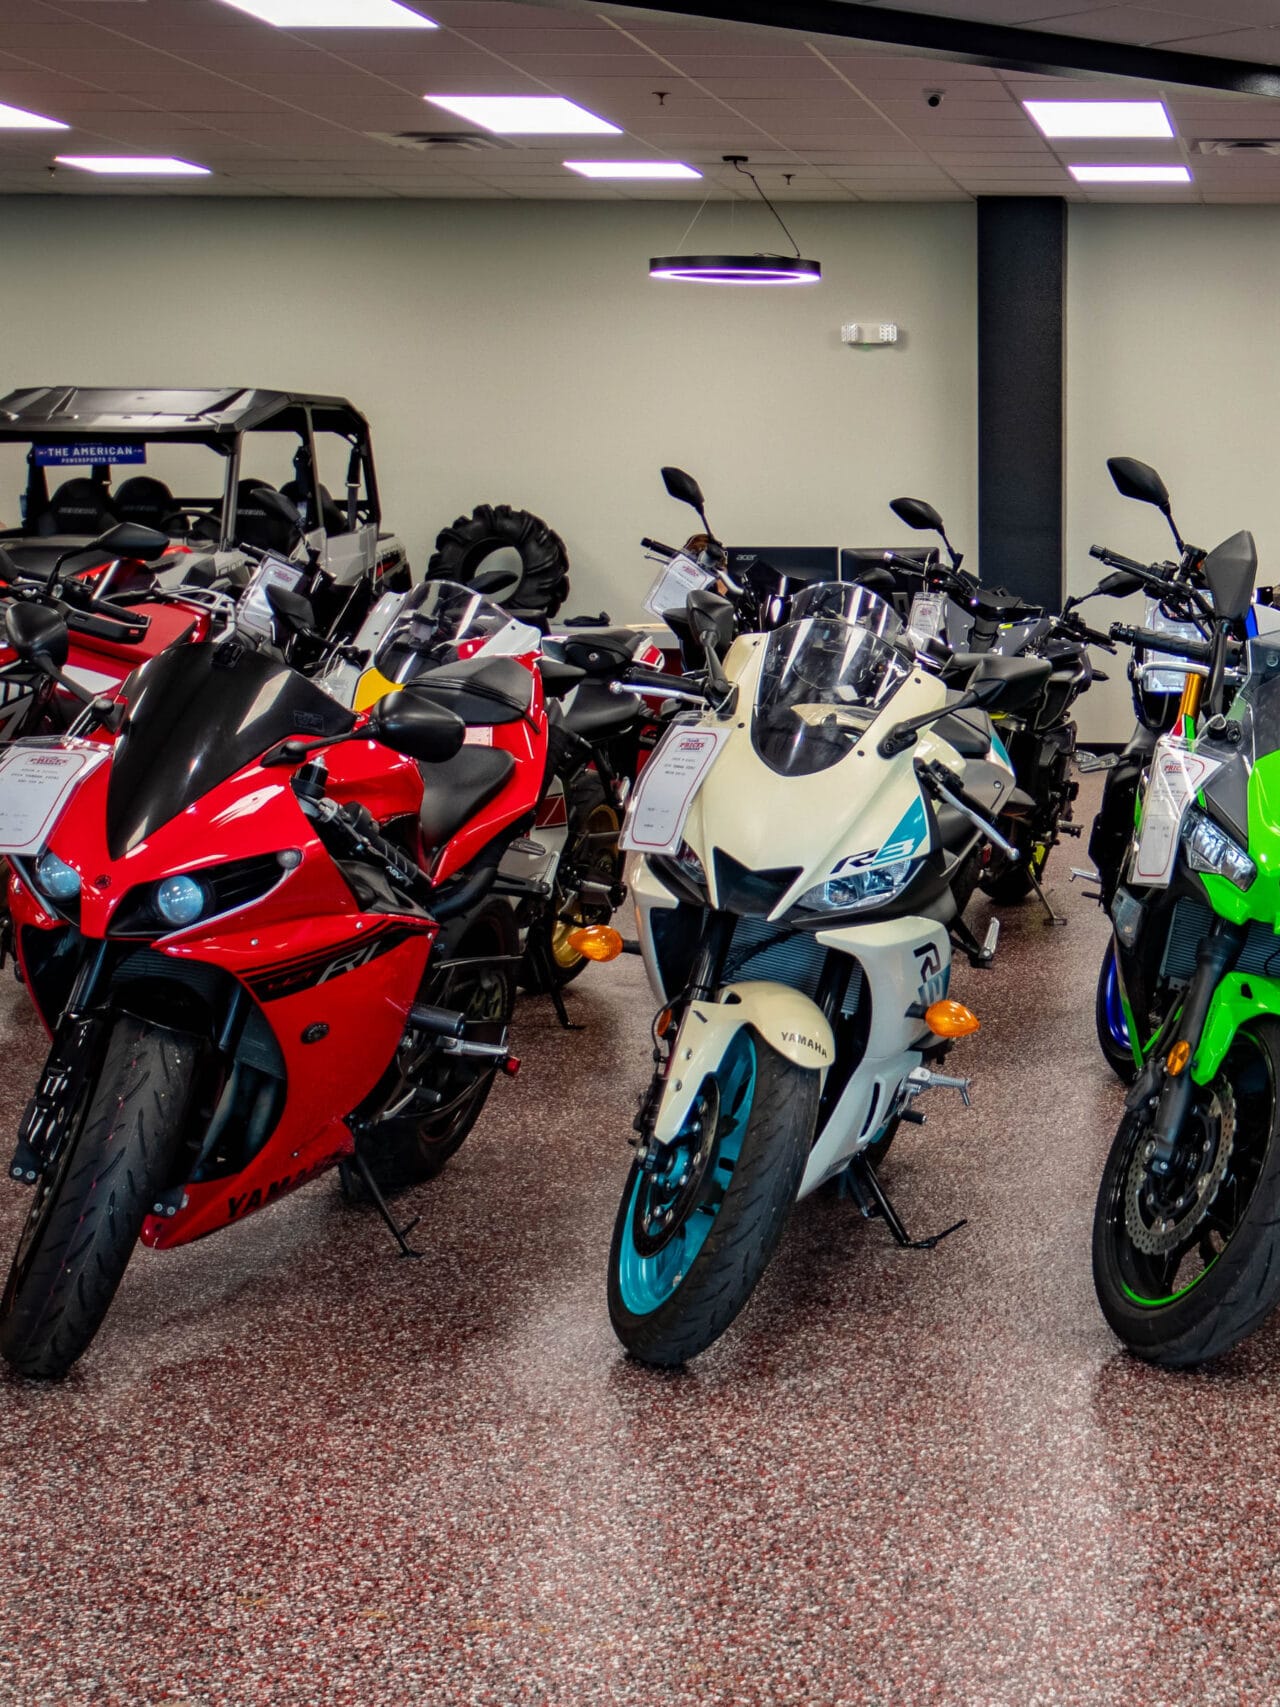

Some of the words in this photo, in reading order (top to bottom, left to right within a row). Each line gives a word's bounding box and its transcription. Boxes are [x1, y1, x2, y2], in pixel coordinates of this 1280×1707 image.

[47, 447, 69, 456] THE
[73, 446, 133, 456] AMERICAN
[829, 838, 915, 875] R3
[780, 1031, 828, 1059] YAMAHA
